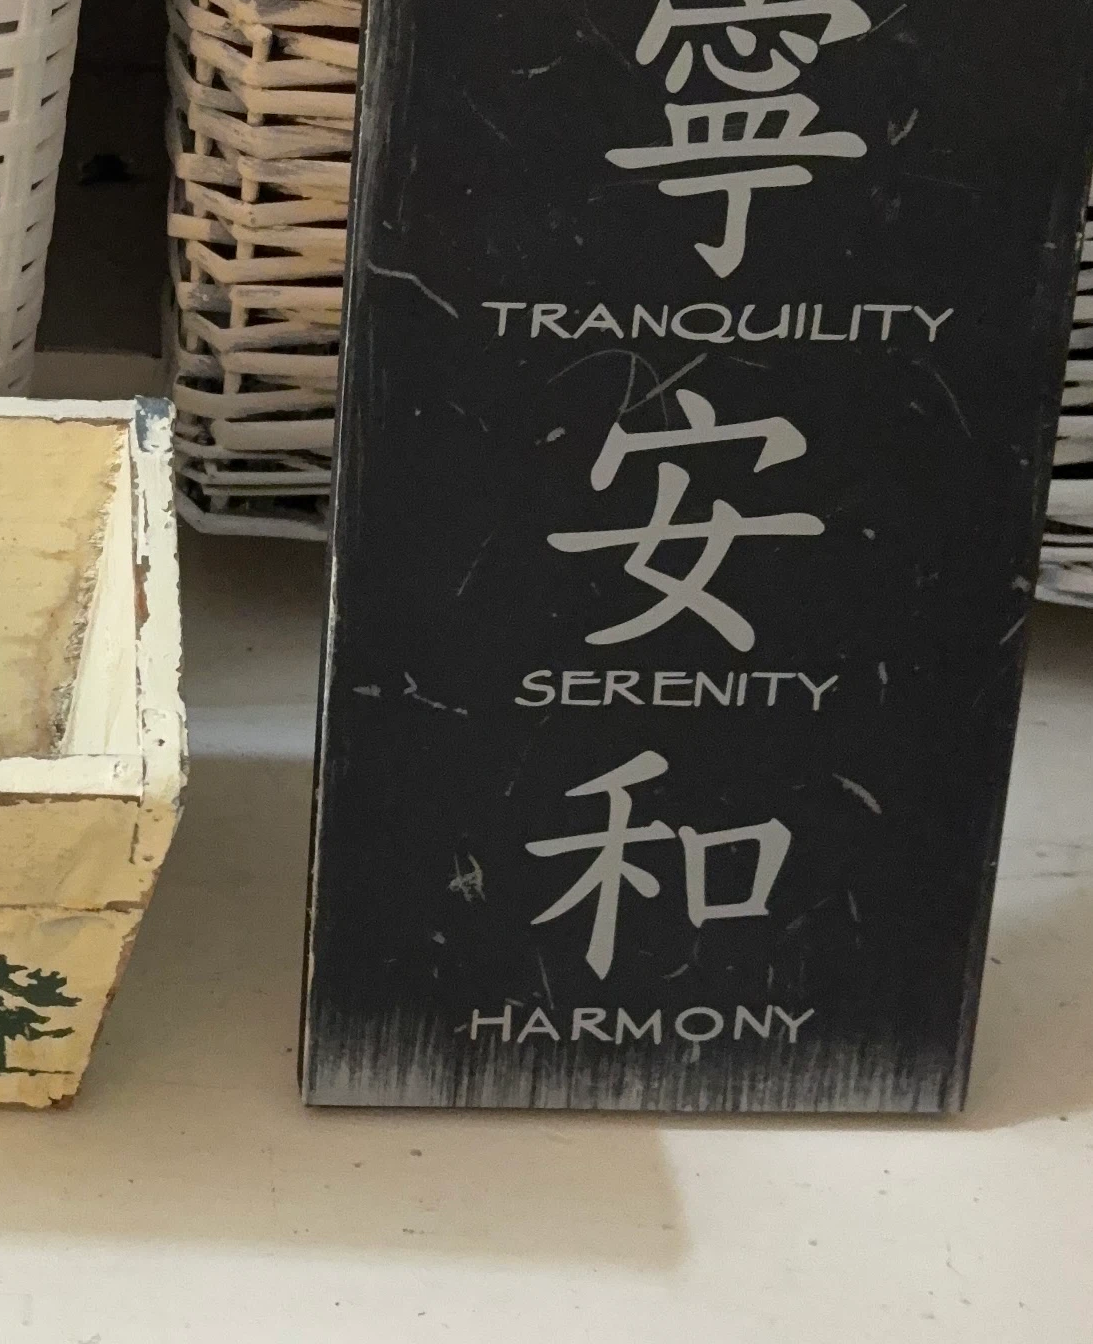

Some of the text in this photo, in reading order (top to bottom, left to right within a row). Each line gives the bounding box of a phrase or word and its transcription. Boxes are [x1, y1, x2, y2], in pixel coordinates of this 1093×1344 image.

[483, 302, 954, 344] TRANQUILITY
[547, 389, 824, 652] 安
[514, 670, 838, 711] SERENITY
[526, 750, 792, 980] 和
[470, 1005, 815, 1044] HARMONY
